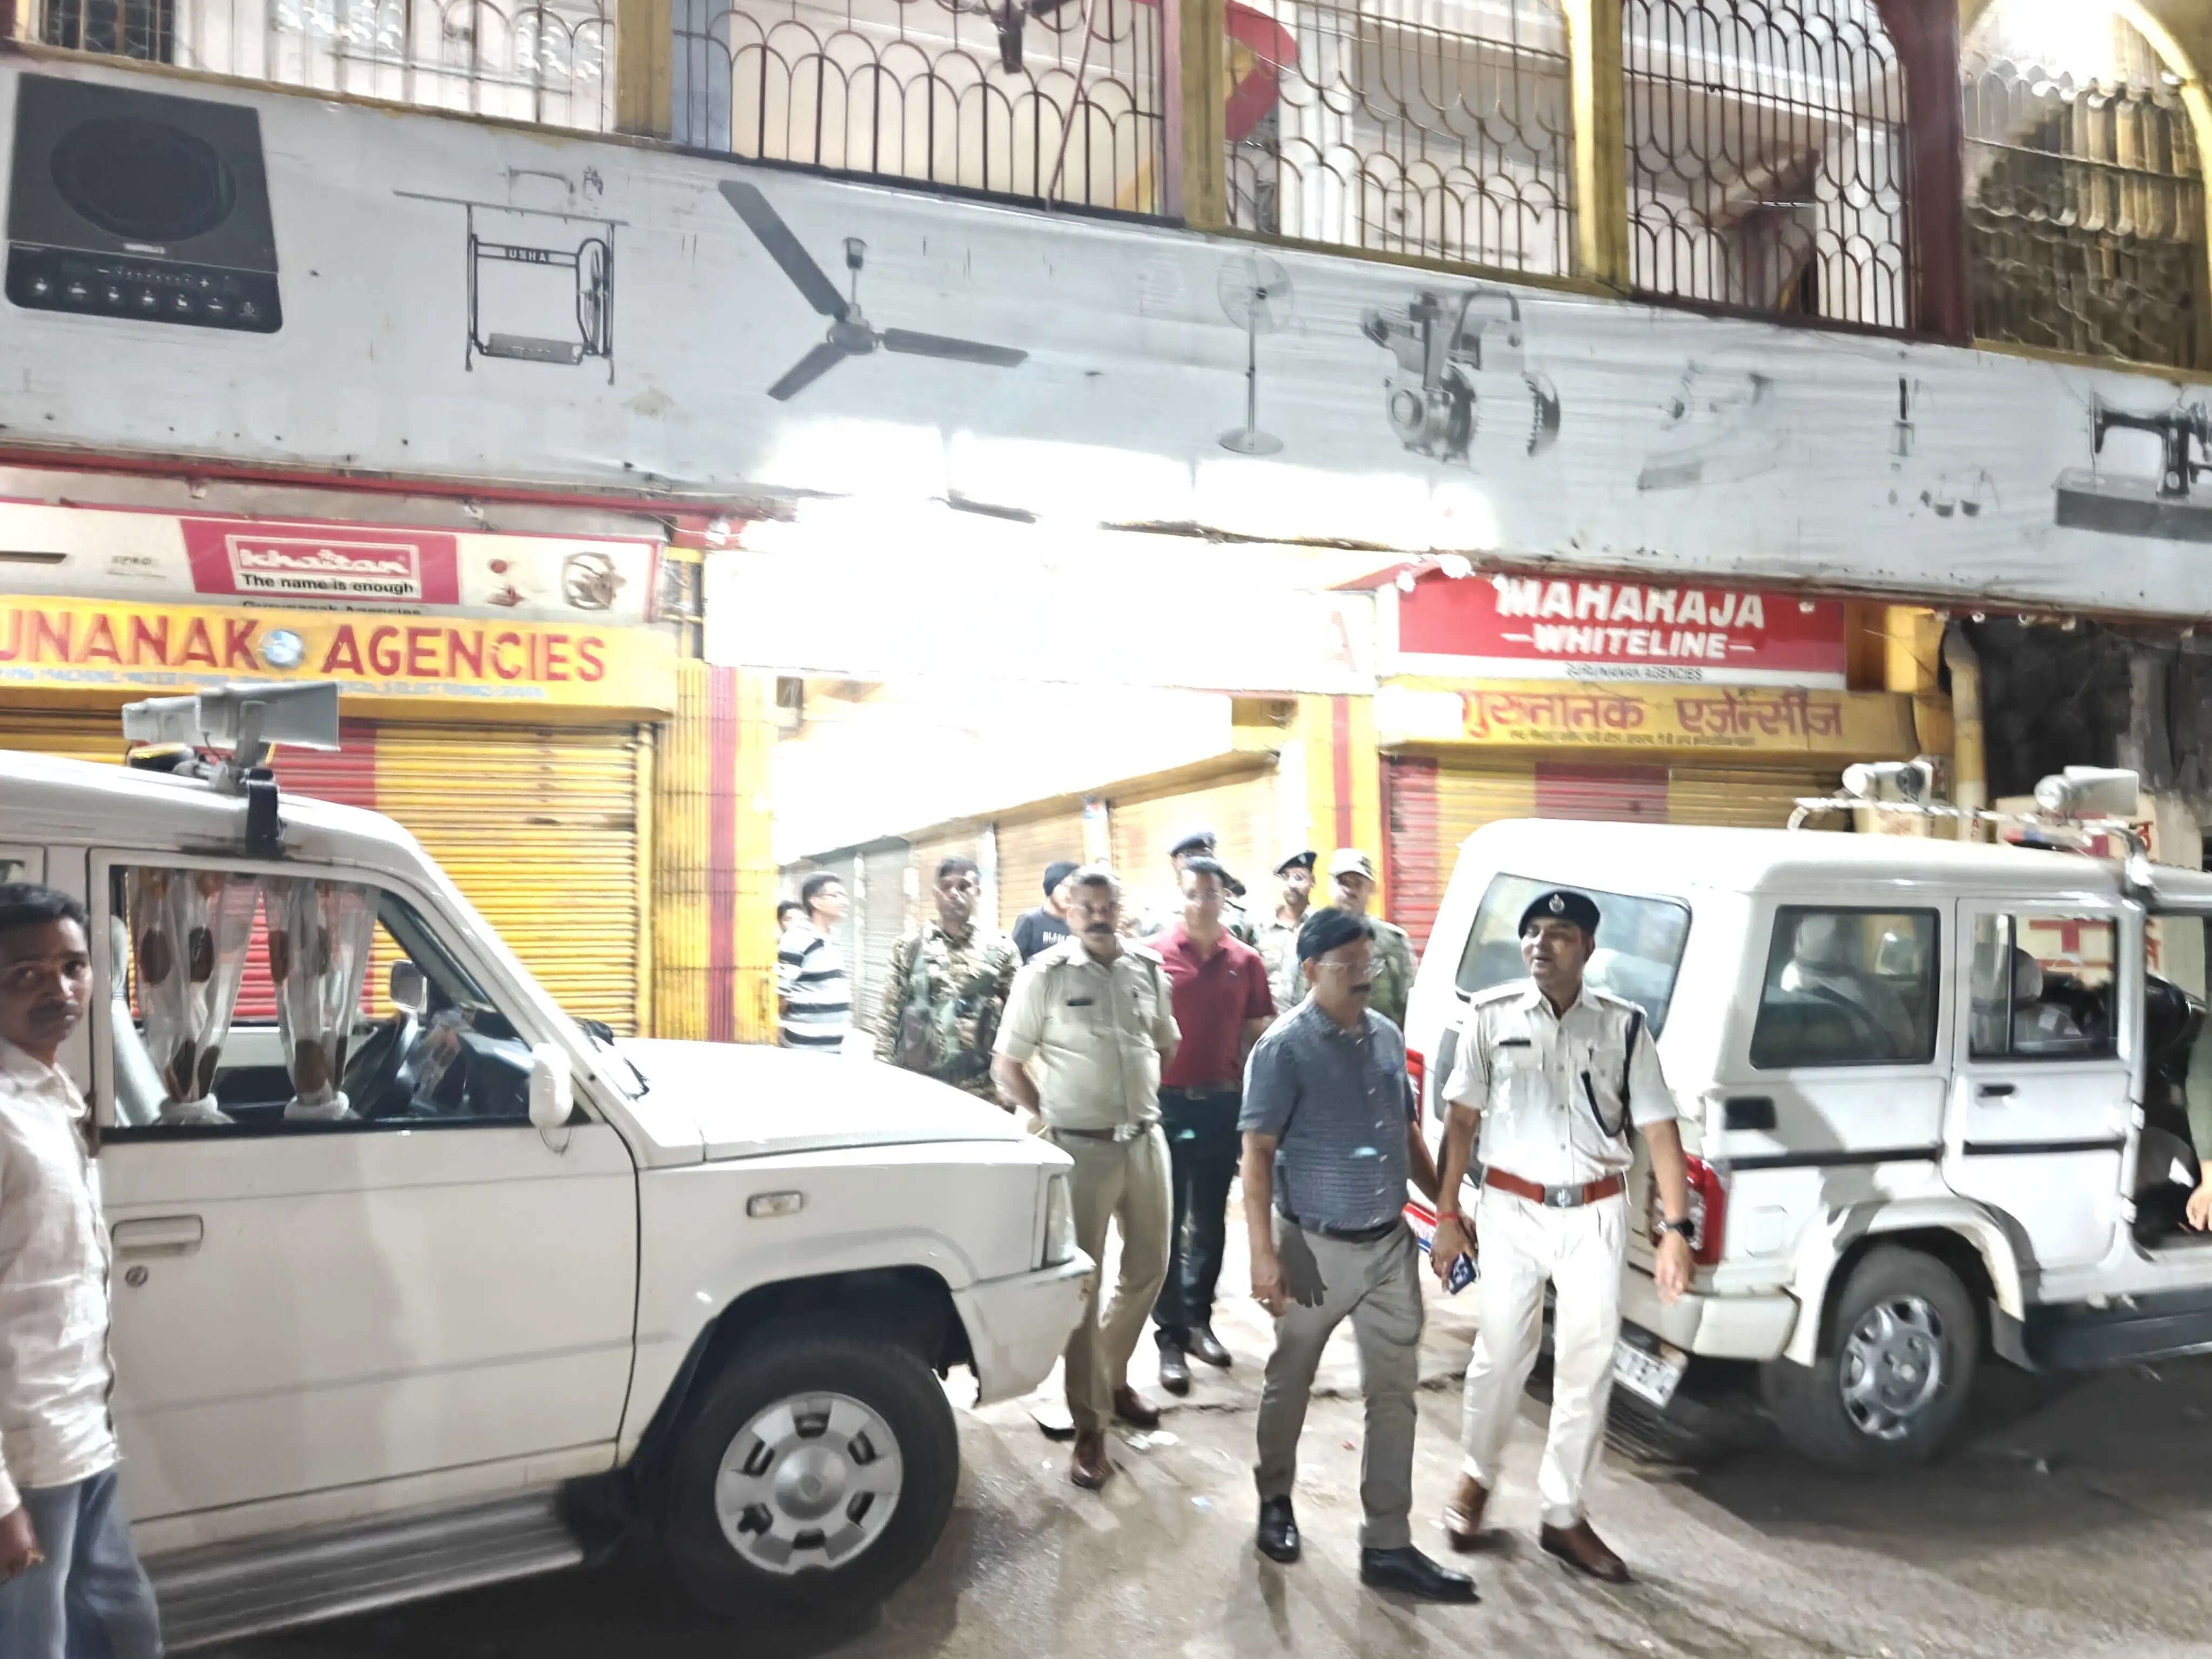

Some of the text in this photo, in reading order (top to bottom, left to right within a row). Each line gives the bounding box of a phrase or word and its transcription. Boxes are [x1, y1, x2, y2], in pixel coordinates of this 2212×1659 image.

[509, 249, 547, 262] USHA
[242, 574, 414, 595] The name is enough
[1496, 578, 1765, 630] MAHARAJA
[321, 624, 606, 682] AGENCIES
[1533, 623, 1728, 659] WHITELINE
